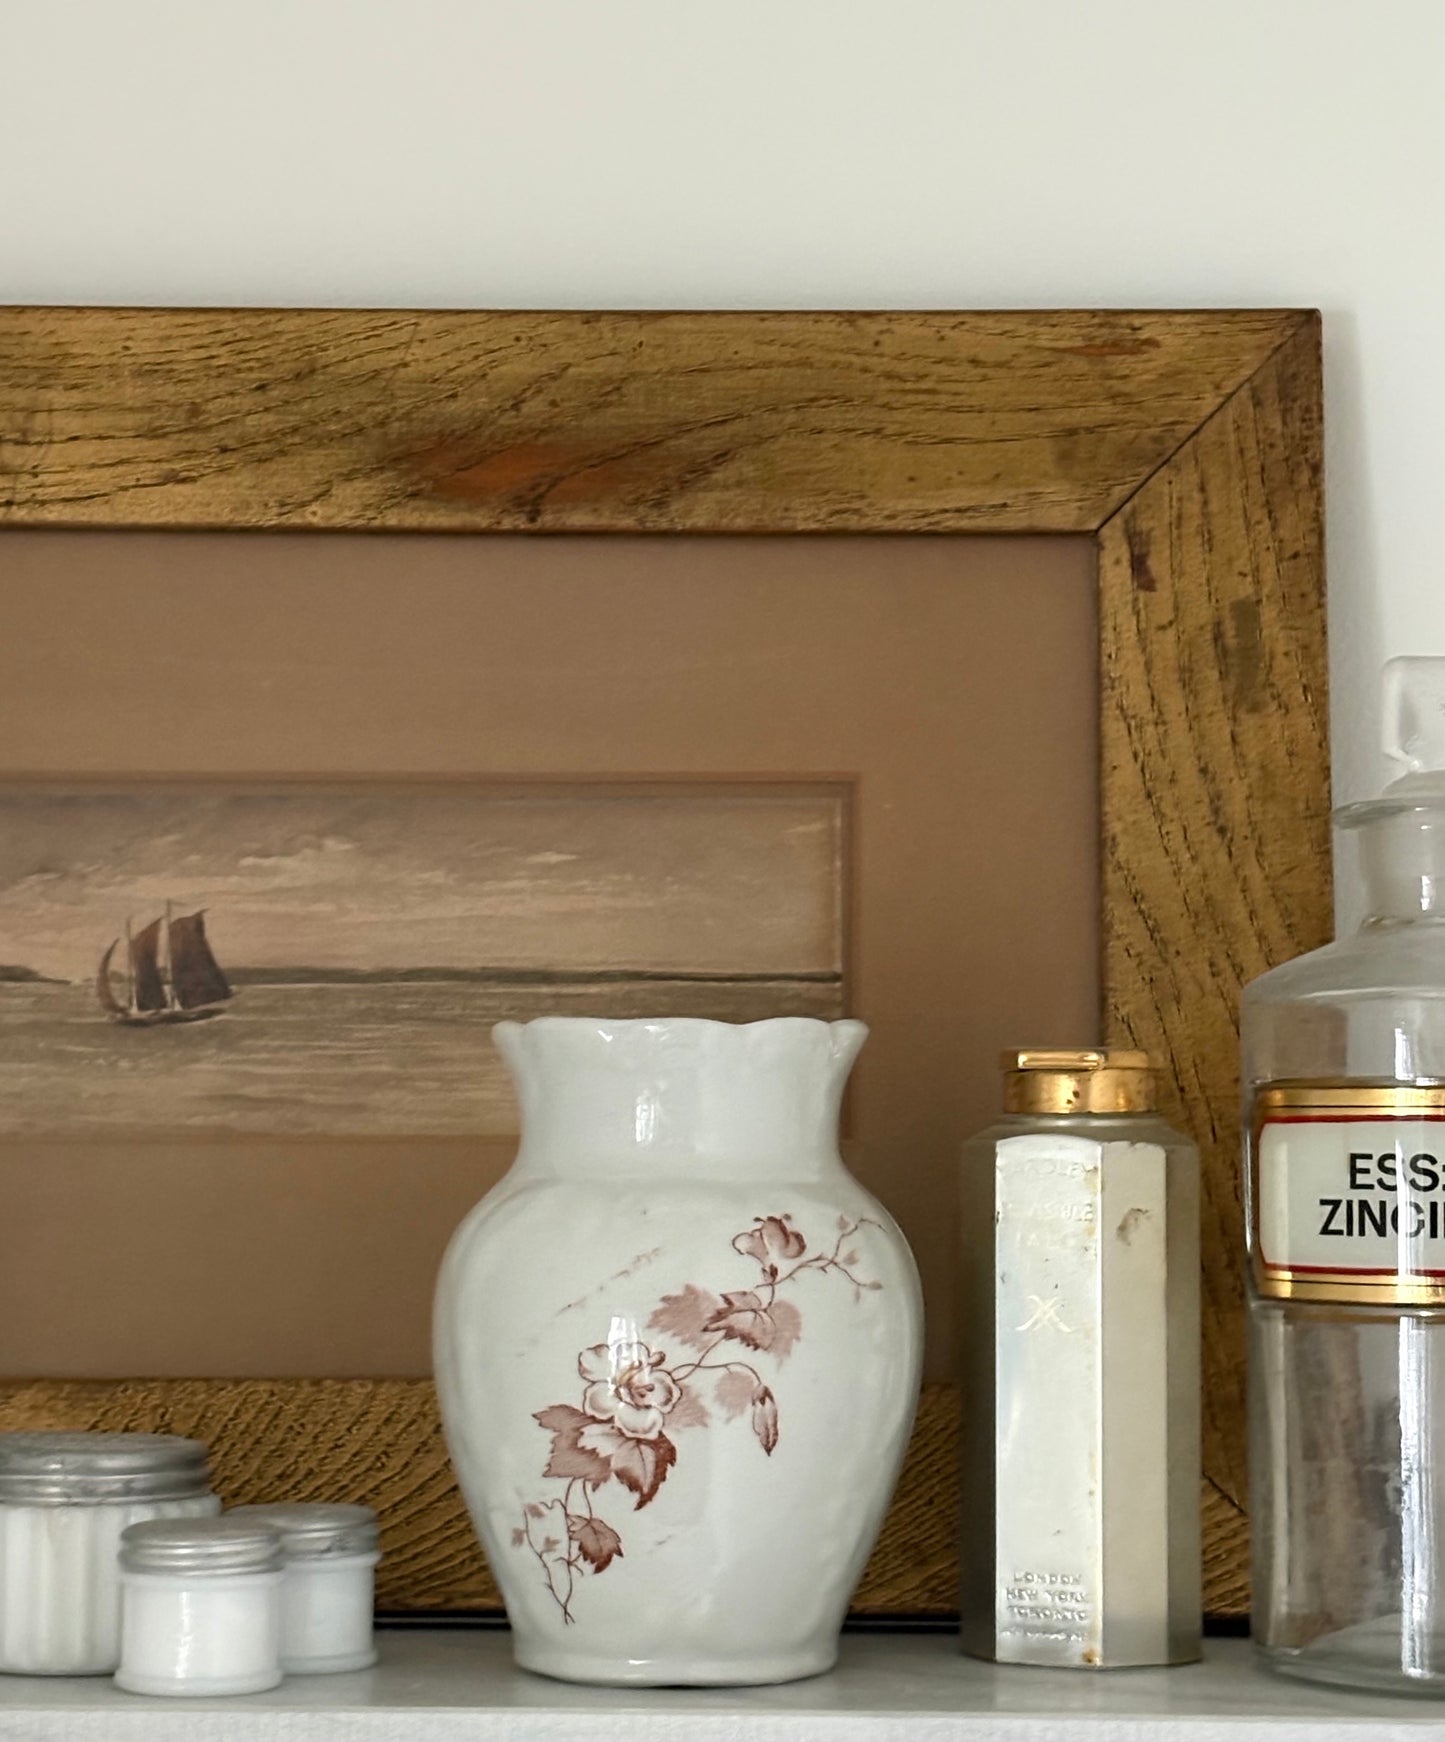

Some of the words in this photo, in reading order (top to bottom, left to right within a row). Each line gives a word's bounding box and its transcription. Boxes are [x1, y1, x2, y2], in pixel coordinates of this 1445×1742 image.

[1318, 1199, 1445, 1239] ZINGI
[1013, 1571, 1082, 1586] LONDON
[1006, 1587, 1038, 1601] NEW
[1043, 1590, 1088, 1603] YORK
[1006, 1605, 1087, 1622] TORONTO
